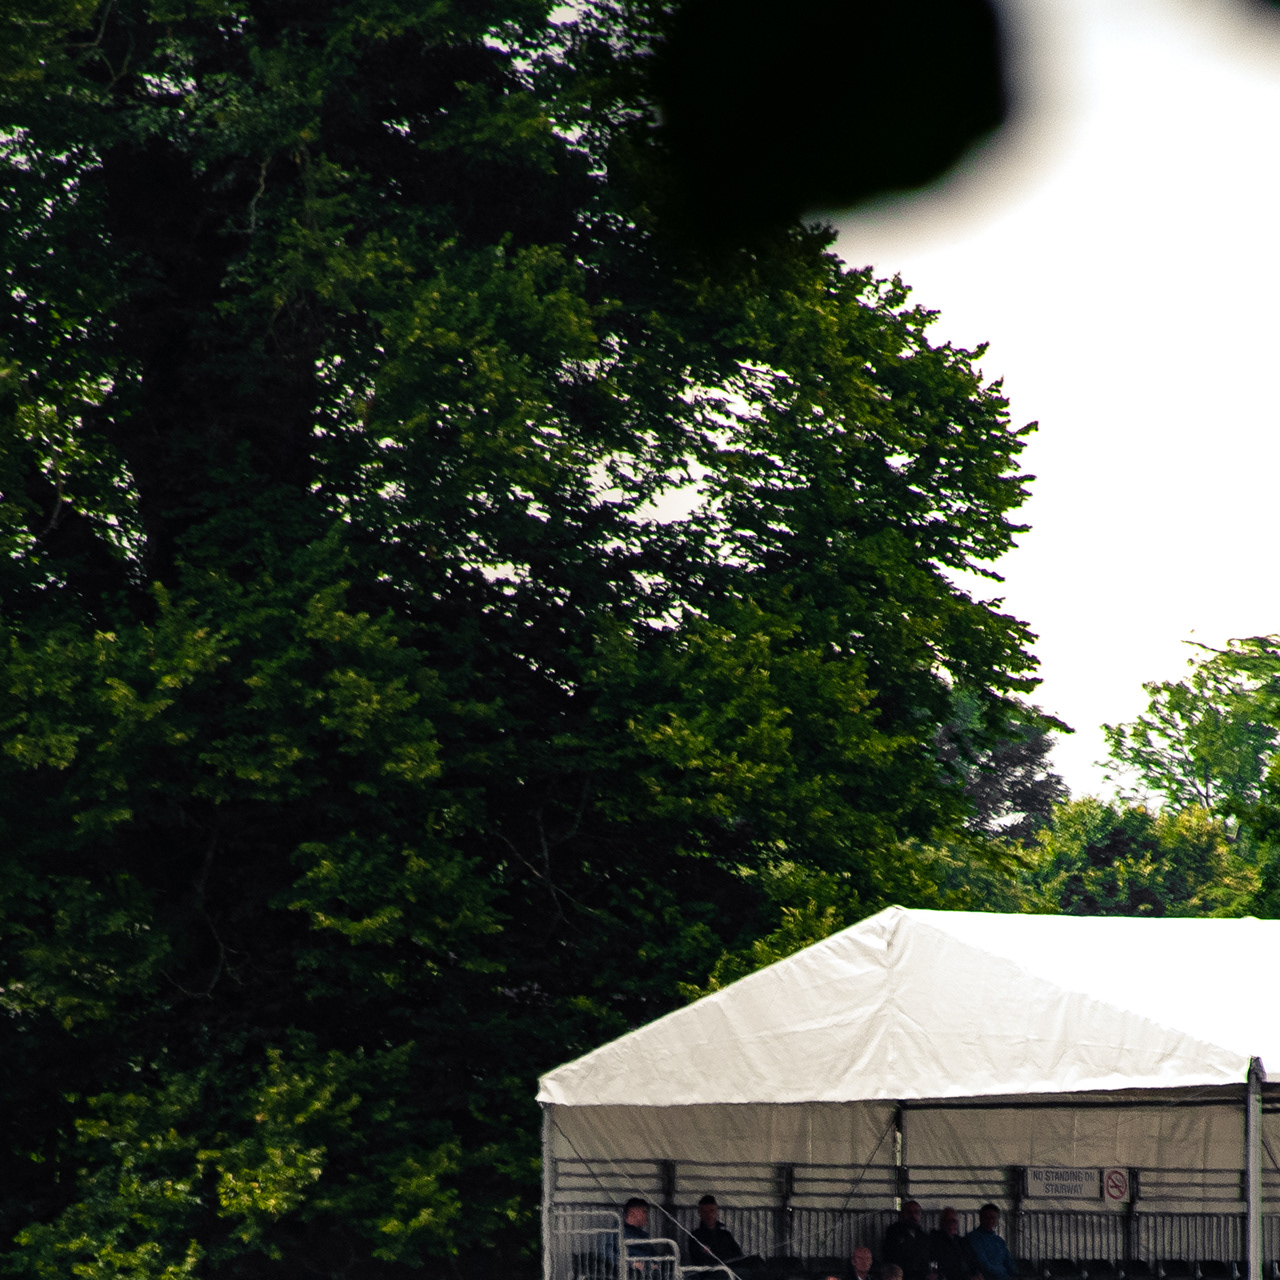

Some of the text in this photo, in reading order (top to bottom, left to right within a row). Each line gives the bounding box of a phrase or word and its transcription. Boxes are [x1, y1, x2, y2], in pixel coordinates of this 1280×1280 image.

[1033, 1171, 1043, 1181] NO
[1045, 1170, 1082, 1181] STANDING
[1044, 1184, 1083, 1194] STAIRWAY
